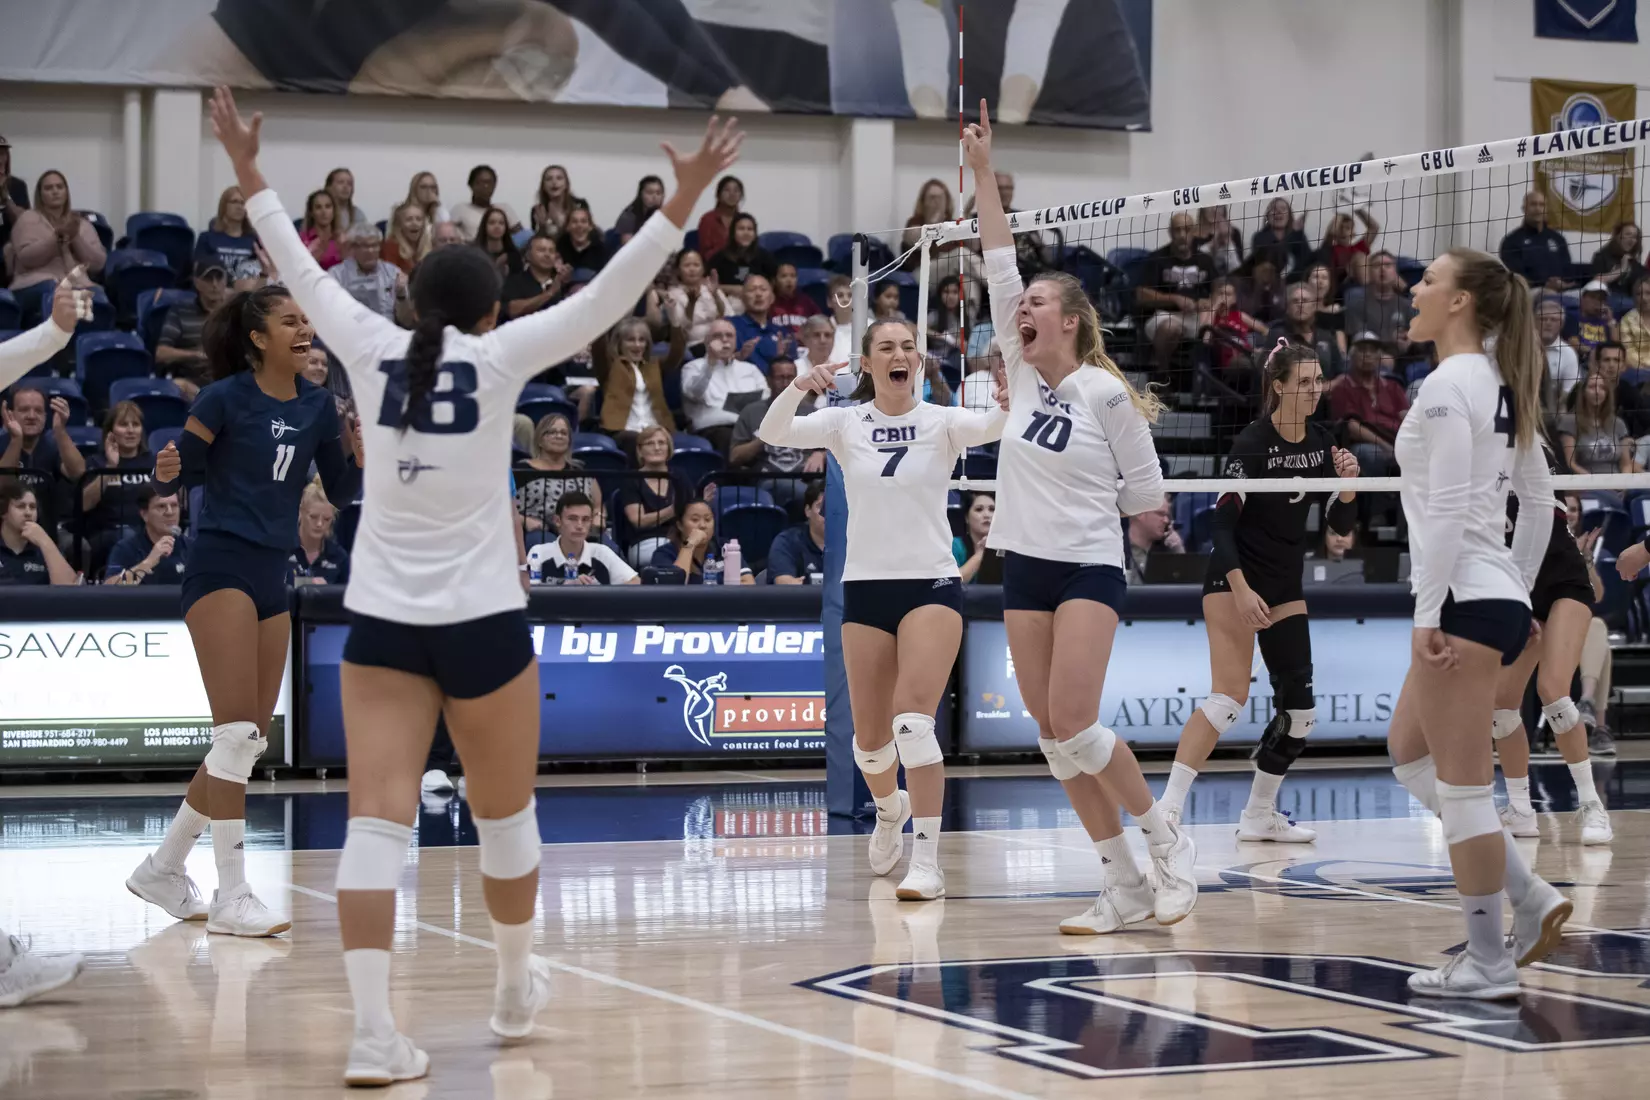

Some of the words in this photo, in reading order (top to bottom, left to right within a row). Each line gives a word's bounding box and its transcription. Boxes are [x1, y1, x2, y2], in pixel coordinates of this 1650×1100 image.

[1034, 197, 1127, 225] #LANCEUP
[1173, 187, 1200, 206] CBU
[1250, 162, 1363, 196] #LANCEUP
[1421, 149, 1455, 171] CBU
[377, 359, 479, 434] 18
[1106, 391, 1127, 410] WAC
[1424, 405, 1448, 419] WAC
[872, 425, 917, 443] CBU
[1021, 410, 1073, 453] 10
[273, 444, 296, 482] 11
[877, 446, 909, 477] 7
[1267, 456, 1283, 470] NEW
[1284, 453, 1309, 469] MEXICO
[560, 625, 618, 663] by
[633, 625, 824, 655] Provider
[1250, 692, 1393, 726] HTELS
[3, 730, 43, 739] RIVERSIDE
[44, 729, 96, 738] 951-684-2171
[144, 728, 160, 737] LOS
[162, 727, 199, 737] ANGELES
[3, 740, 20, 748] SAN
[21, 739, 75, 748] BERNARDINO
[76, 738, 129, 747] 909-980-4499
[144, 737, 161, 746] SAN
[163, 737, 191, 746] DIEGO
[723, 739, 770, 750] contract
[774, 738, 800, 749] food
